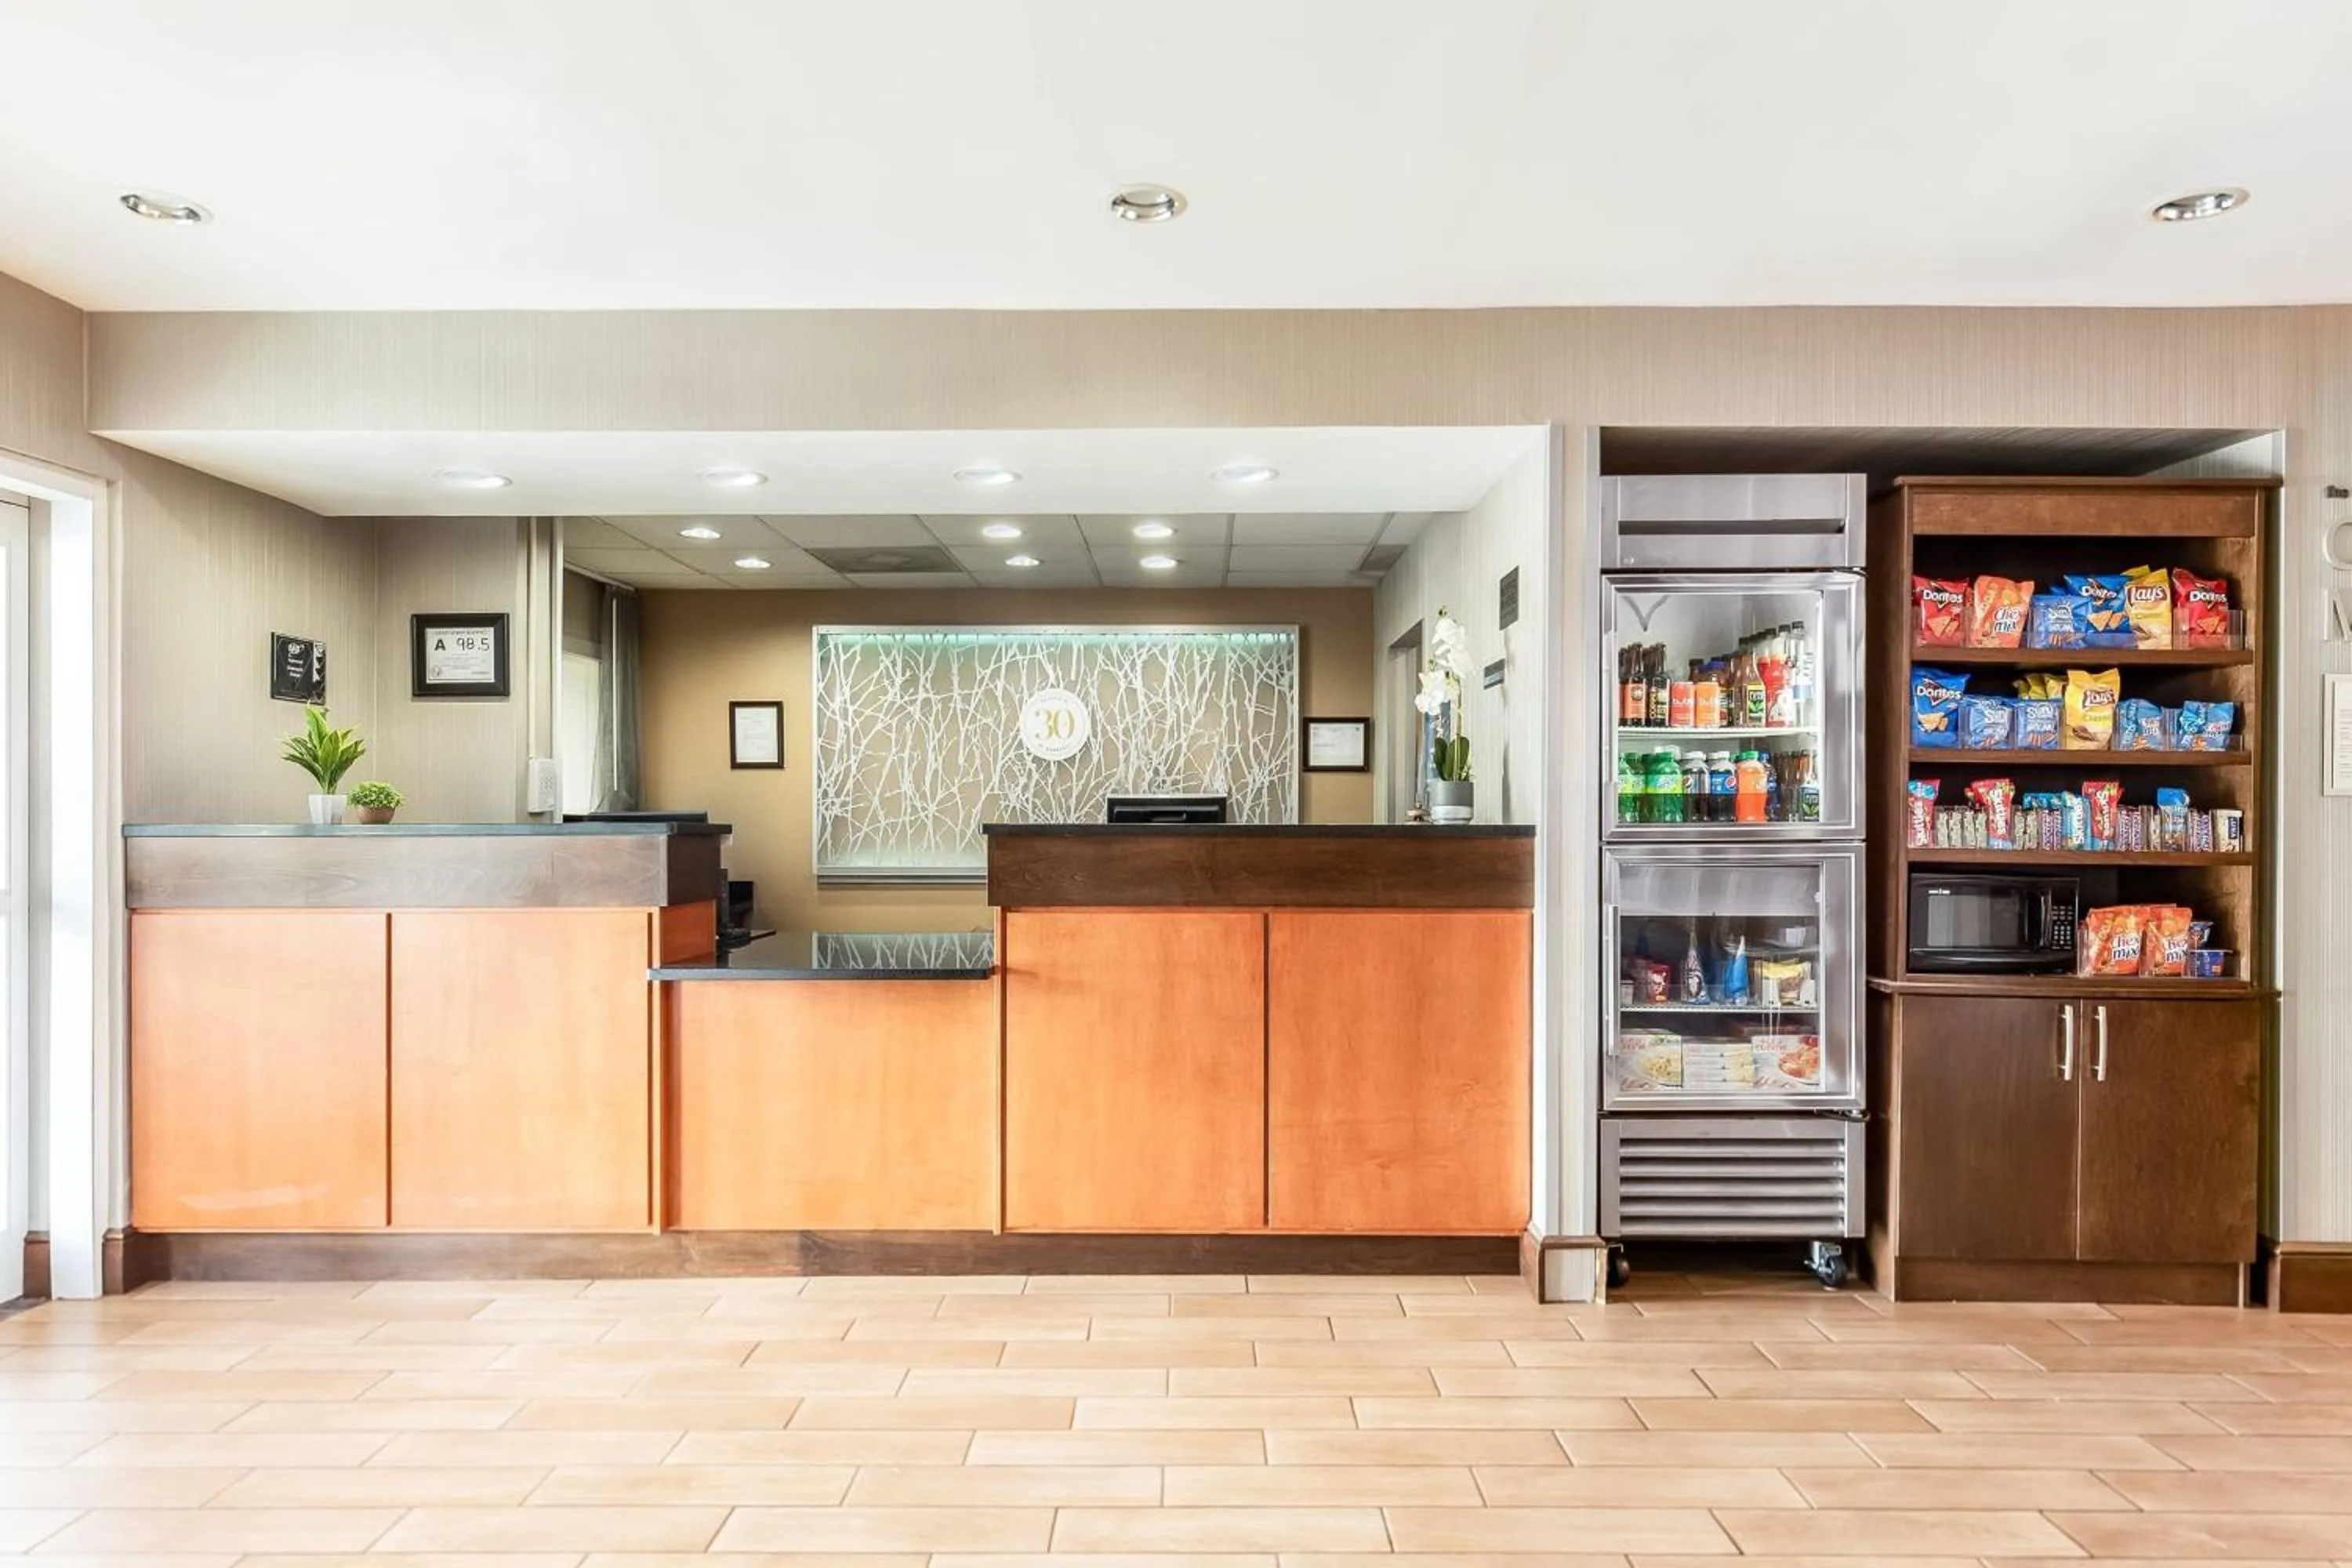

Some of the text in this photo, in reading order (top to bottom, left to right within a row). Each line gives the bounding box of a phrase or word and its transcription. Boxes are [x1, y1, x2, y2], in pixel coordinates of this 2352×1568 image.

[1923, 589, 1963, 604] Doritos
[2189, 590, 2227, 602] Doritos
[434, 637, 490, 652] A 98.5
[1916, 685, 1962, 700] Doritos
